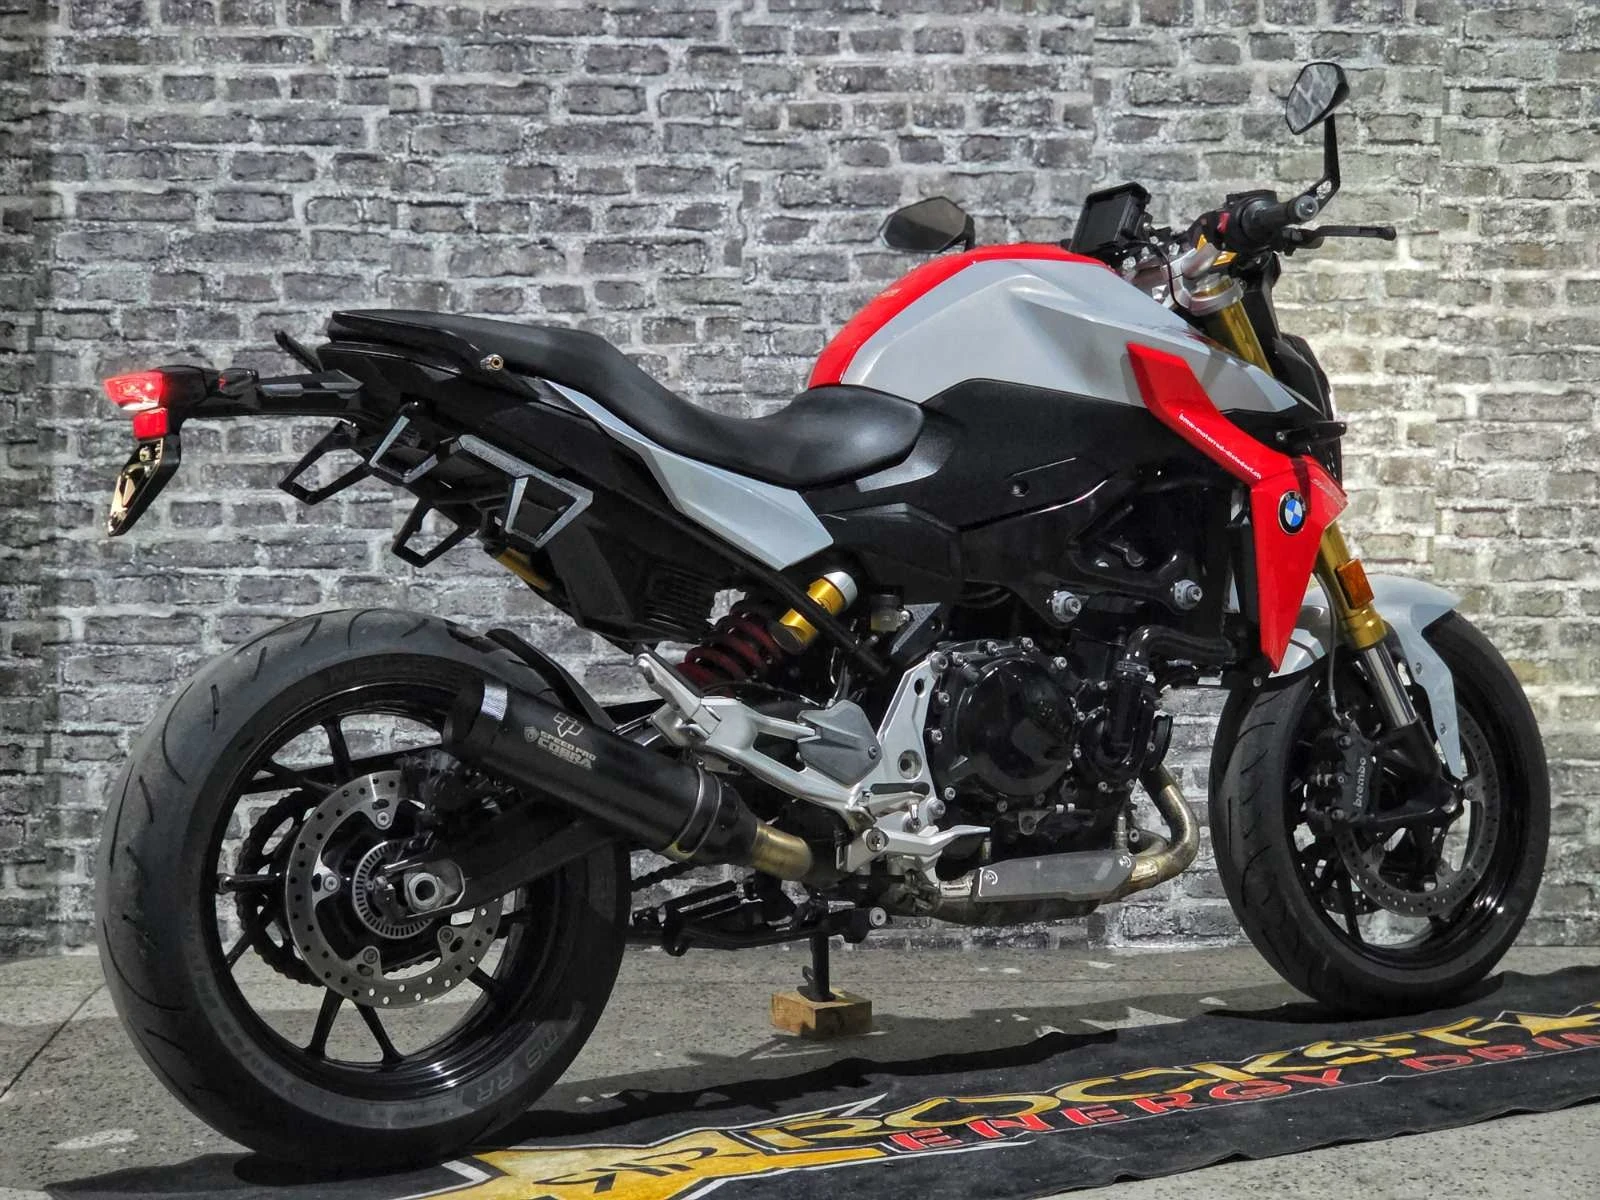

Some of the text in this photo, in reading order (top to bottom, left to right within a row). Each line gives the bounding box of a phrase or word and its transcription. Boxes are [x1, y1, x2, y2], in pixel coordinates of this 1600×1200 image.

[538, 736, 593, 770] COBRA
[540, 730, 597, 761] SPEED PRO
[1352, 757, 1367, 808] brembo
[889, 1067, 1345, 1151] ENERGY
